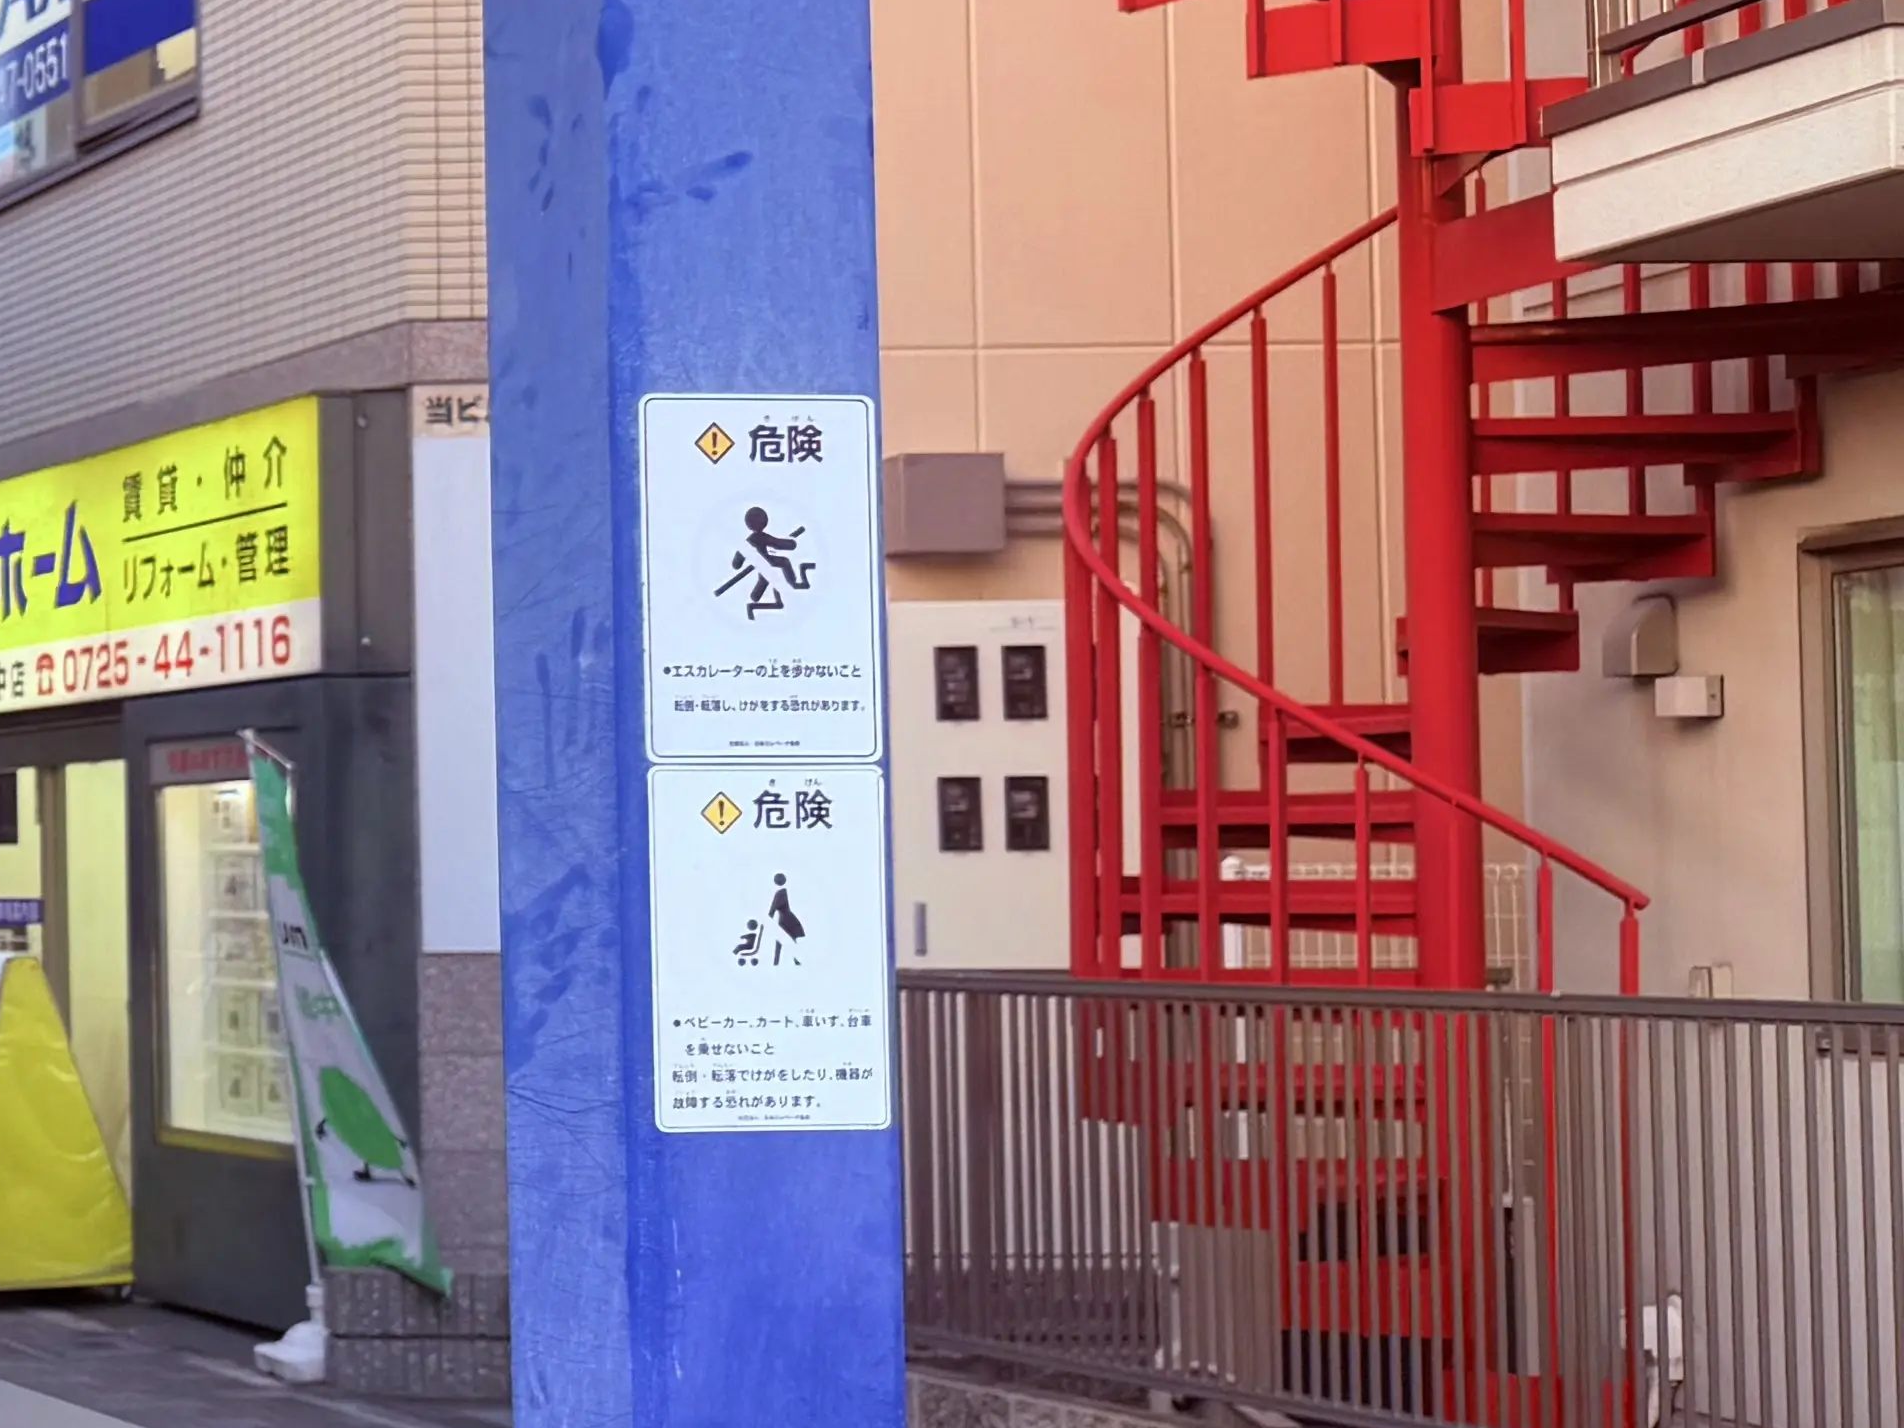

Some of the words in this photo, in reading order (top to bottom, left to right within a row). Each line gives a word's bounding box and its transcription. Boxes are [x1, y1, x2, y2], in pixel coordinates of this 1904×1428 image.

[748, 424, 823, 463] 危険
[63, 615, 291, 693] 0725-44-1116
[753, 789, 833, 829] 危険
